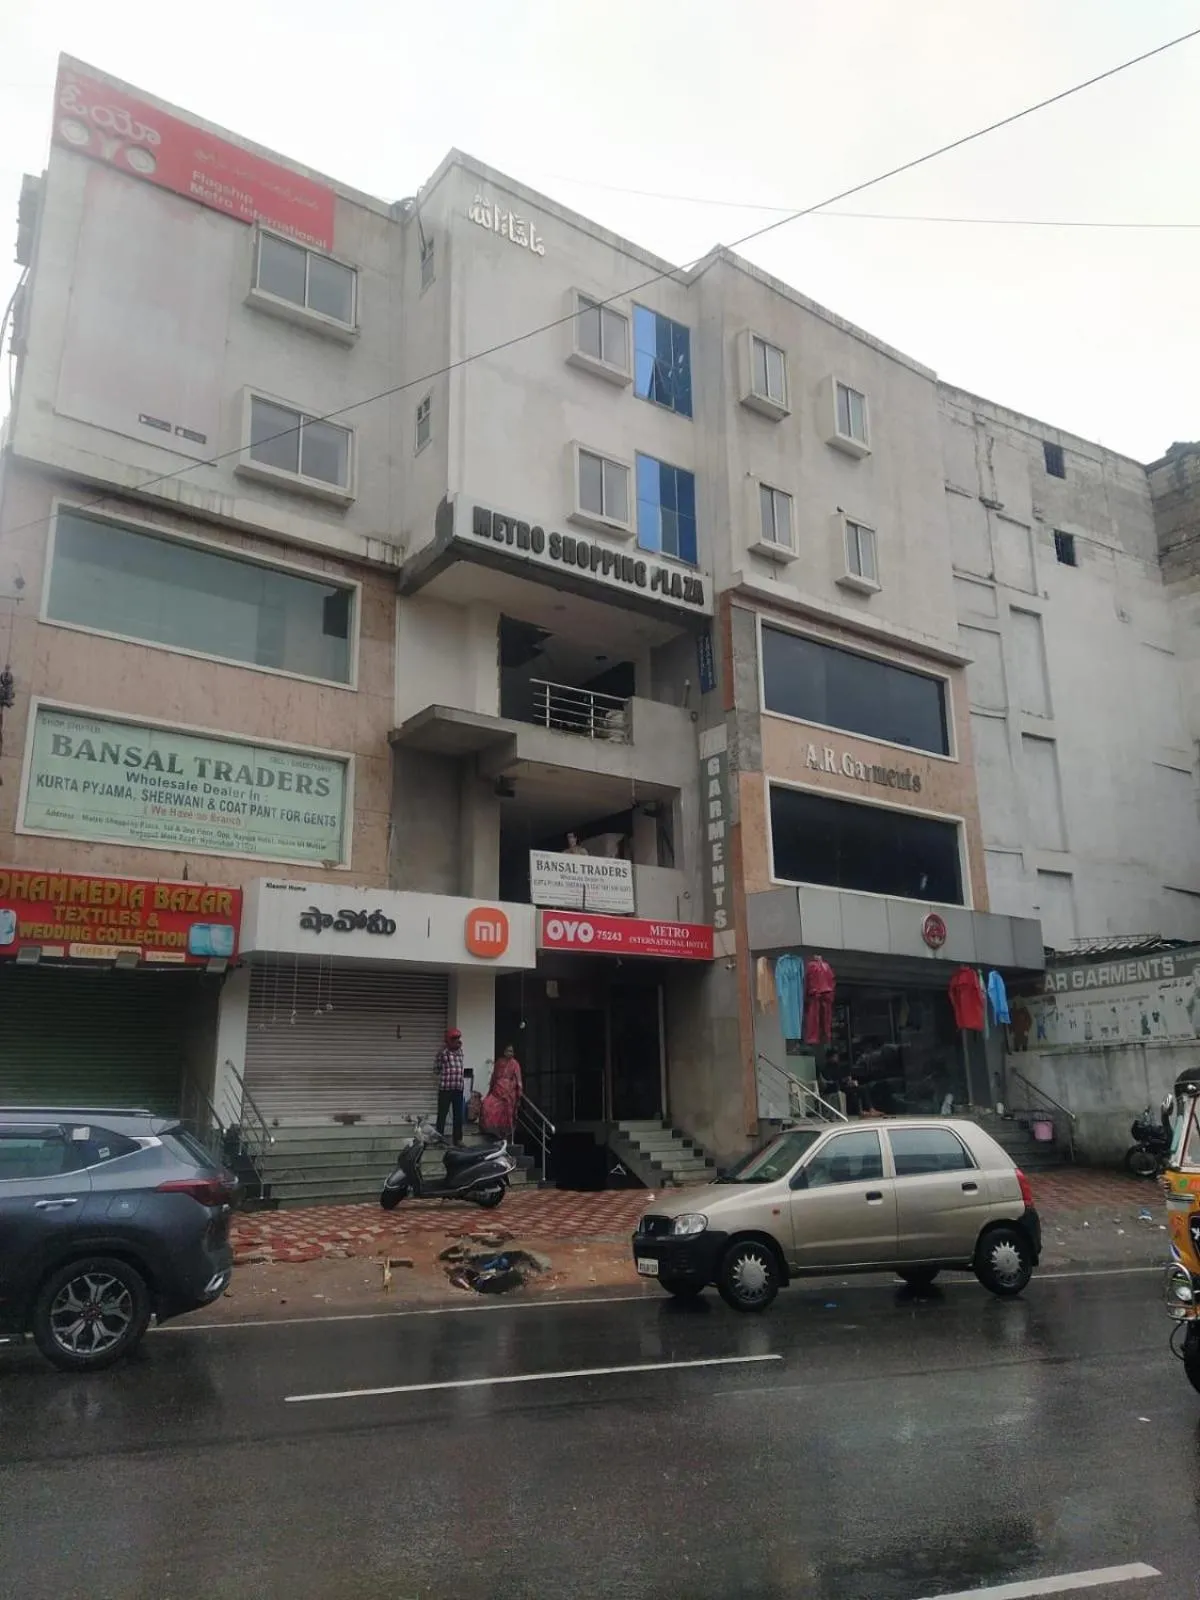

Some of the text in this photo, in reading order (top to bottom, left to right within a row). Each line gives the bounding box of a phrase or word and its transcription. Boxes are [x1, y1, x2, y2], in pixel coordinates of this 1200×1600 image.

[59, 118, 157, 174] OYO
[190, 182, 233, 208] Metro
[473, 505, 705, 606] METRO SHOPPING PLAZA
[51, 733, 184, 775] BANSAL
[193, 756, 331, 797] TRADERS
[126, 771, 198, 792] Wholesale
[36, 774, 79, 793] KURTA
[141, 788, 204, 809] SHERWANI
[207, 797, 216, 811] &
[219, 799, 248, 815] COAT
[250, 803, 277, 819] PANT
[280, 808, 301, 822] FOR
[303, 811, 337, 828] GENTS
[706, 756, 729, 929] GARMENTS
[536, 860, 629, 878] BANSAL TRADERS
[154, 884, 233, 917] BAZAR
[53, 905, 159, 928] TEXTILES &
[18, 921, 187, 947] WEDDING COLLECTION
[547, 919, 623, 943] OYO 75243
[628, 935, 686, 948] INTERNATIONAL
[649, 924, 690, 939] METRO
[1044, 955, 1176, 993] AR GARMENTS
